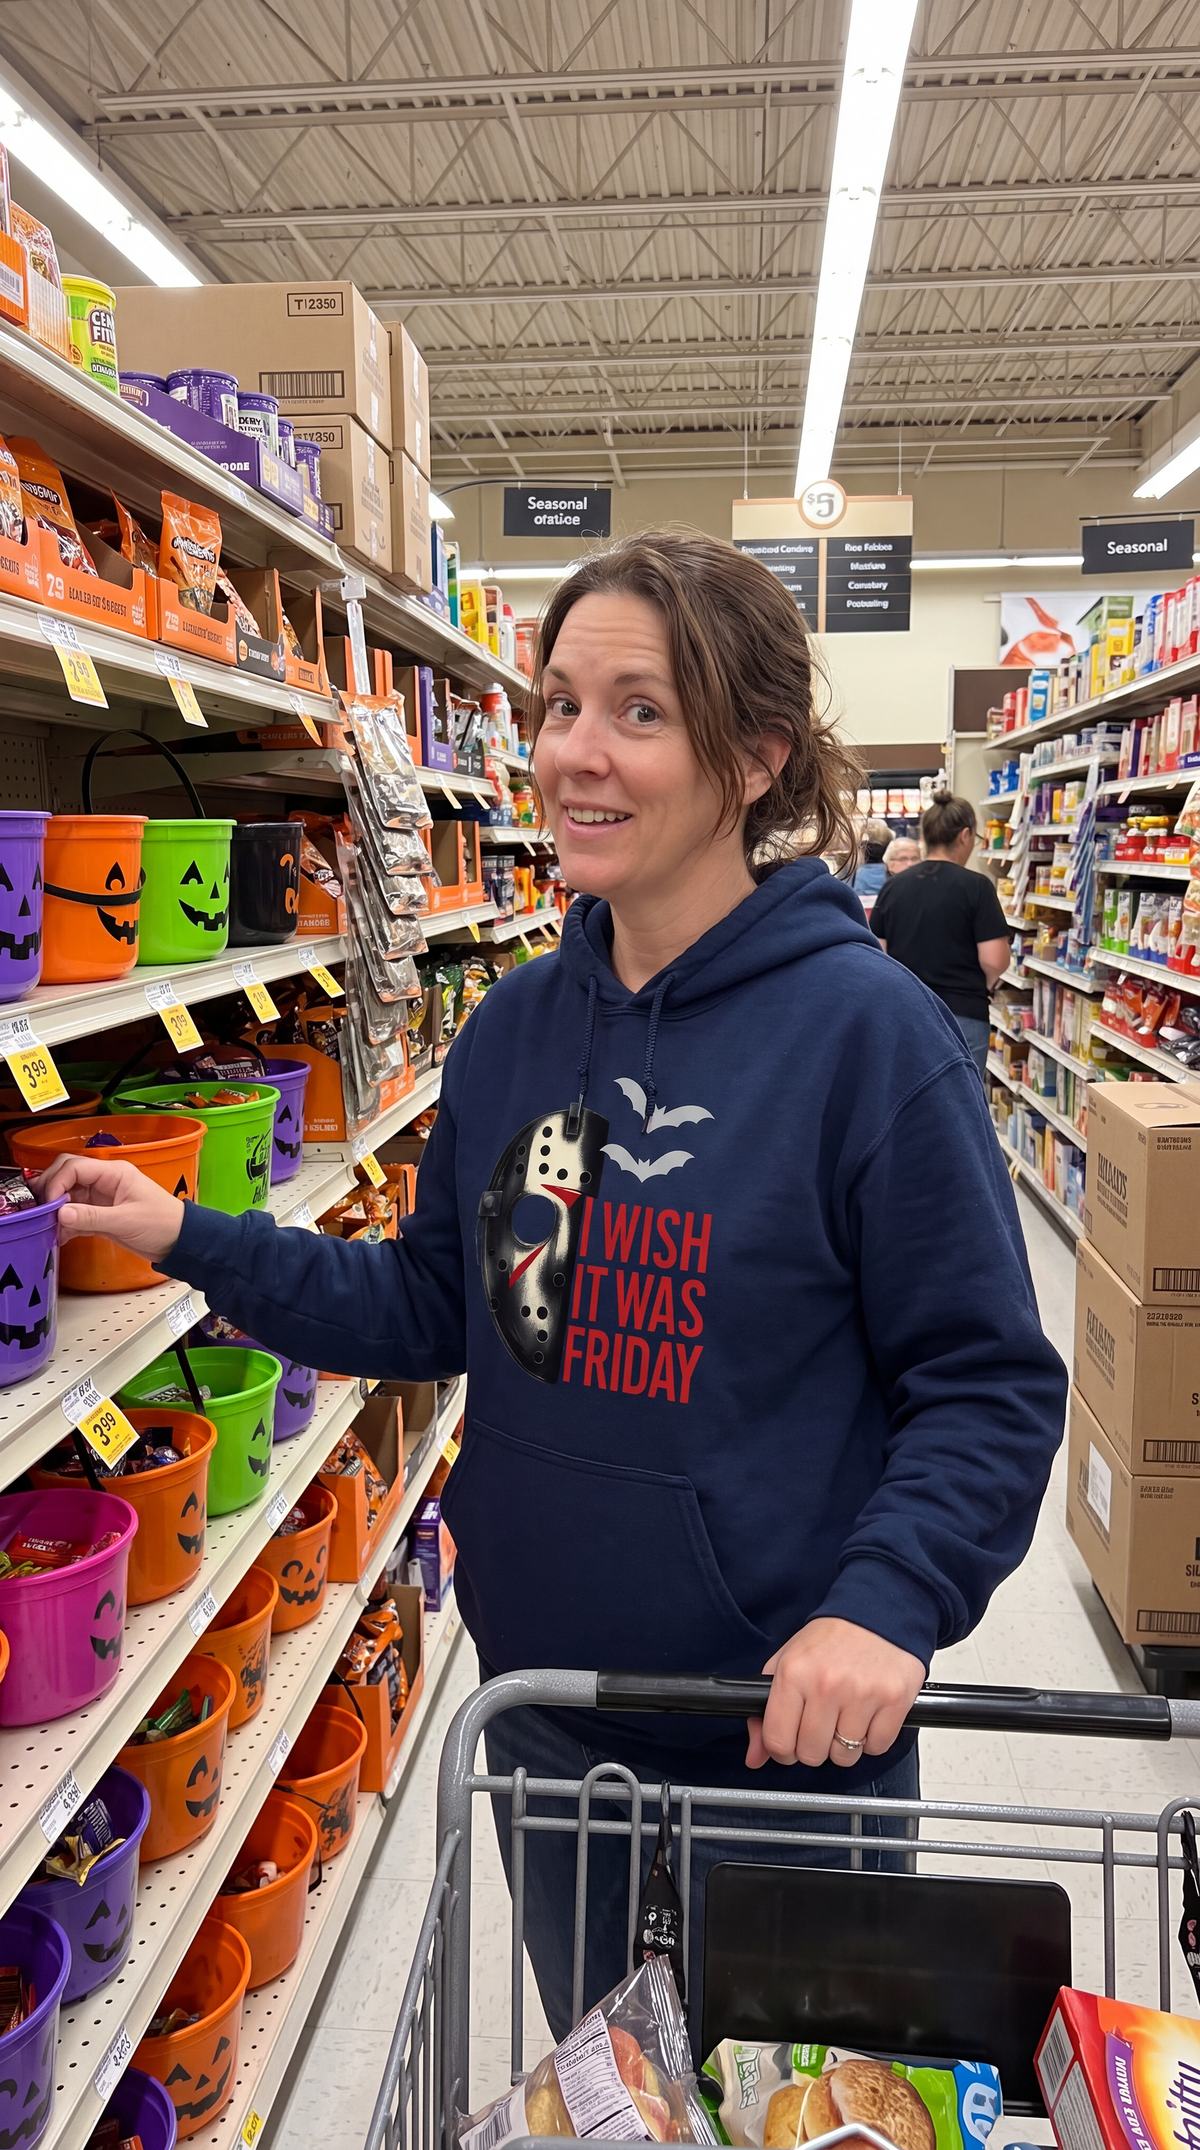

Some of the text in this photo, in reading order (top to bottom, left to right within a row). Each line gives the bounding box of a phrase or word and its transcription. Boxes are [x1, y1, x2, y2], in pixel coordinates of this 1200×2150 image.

[527, 496, 588, 510] Seasonal
[806, 492, 836, 518] $5
[1106, 537, 1168, 555] Seasonal
[579, 1196, 713, 1274] I WISH
[570, 1262, 707, 1339] IT WAS
[562, 1324, 705, 1405] FRIDAY
